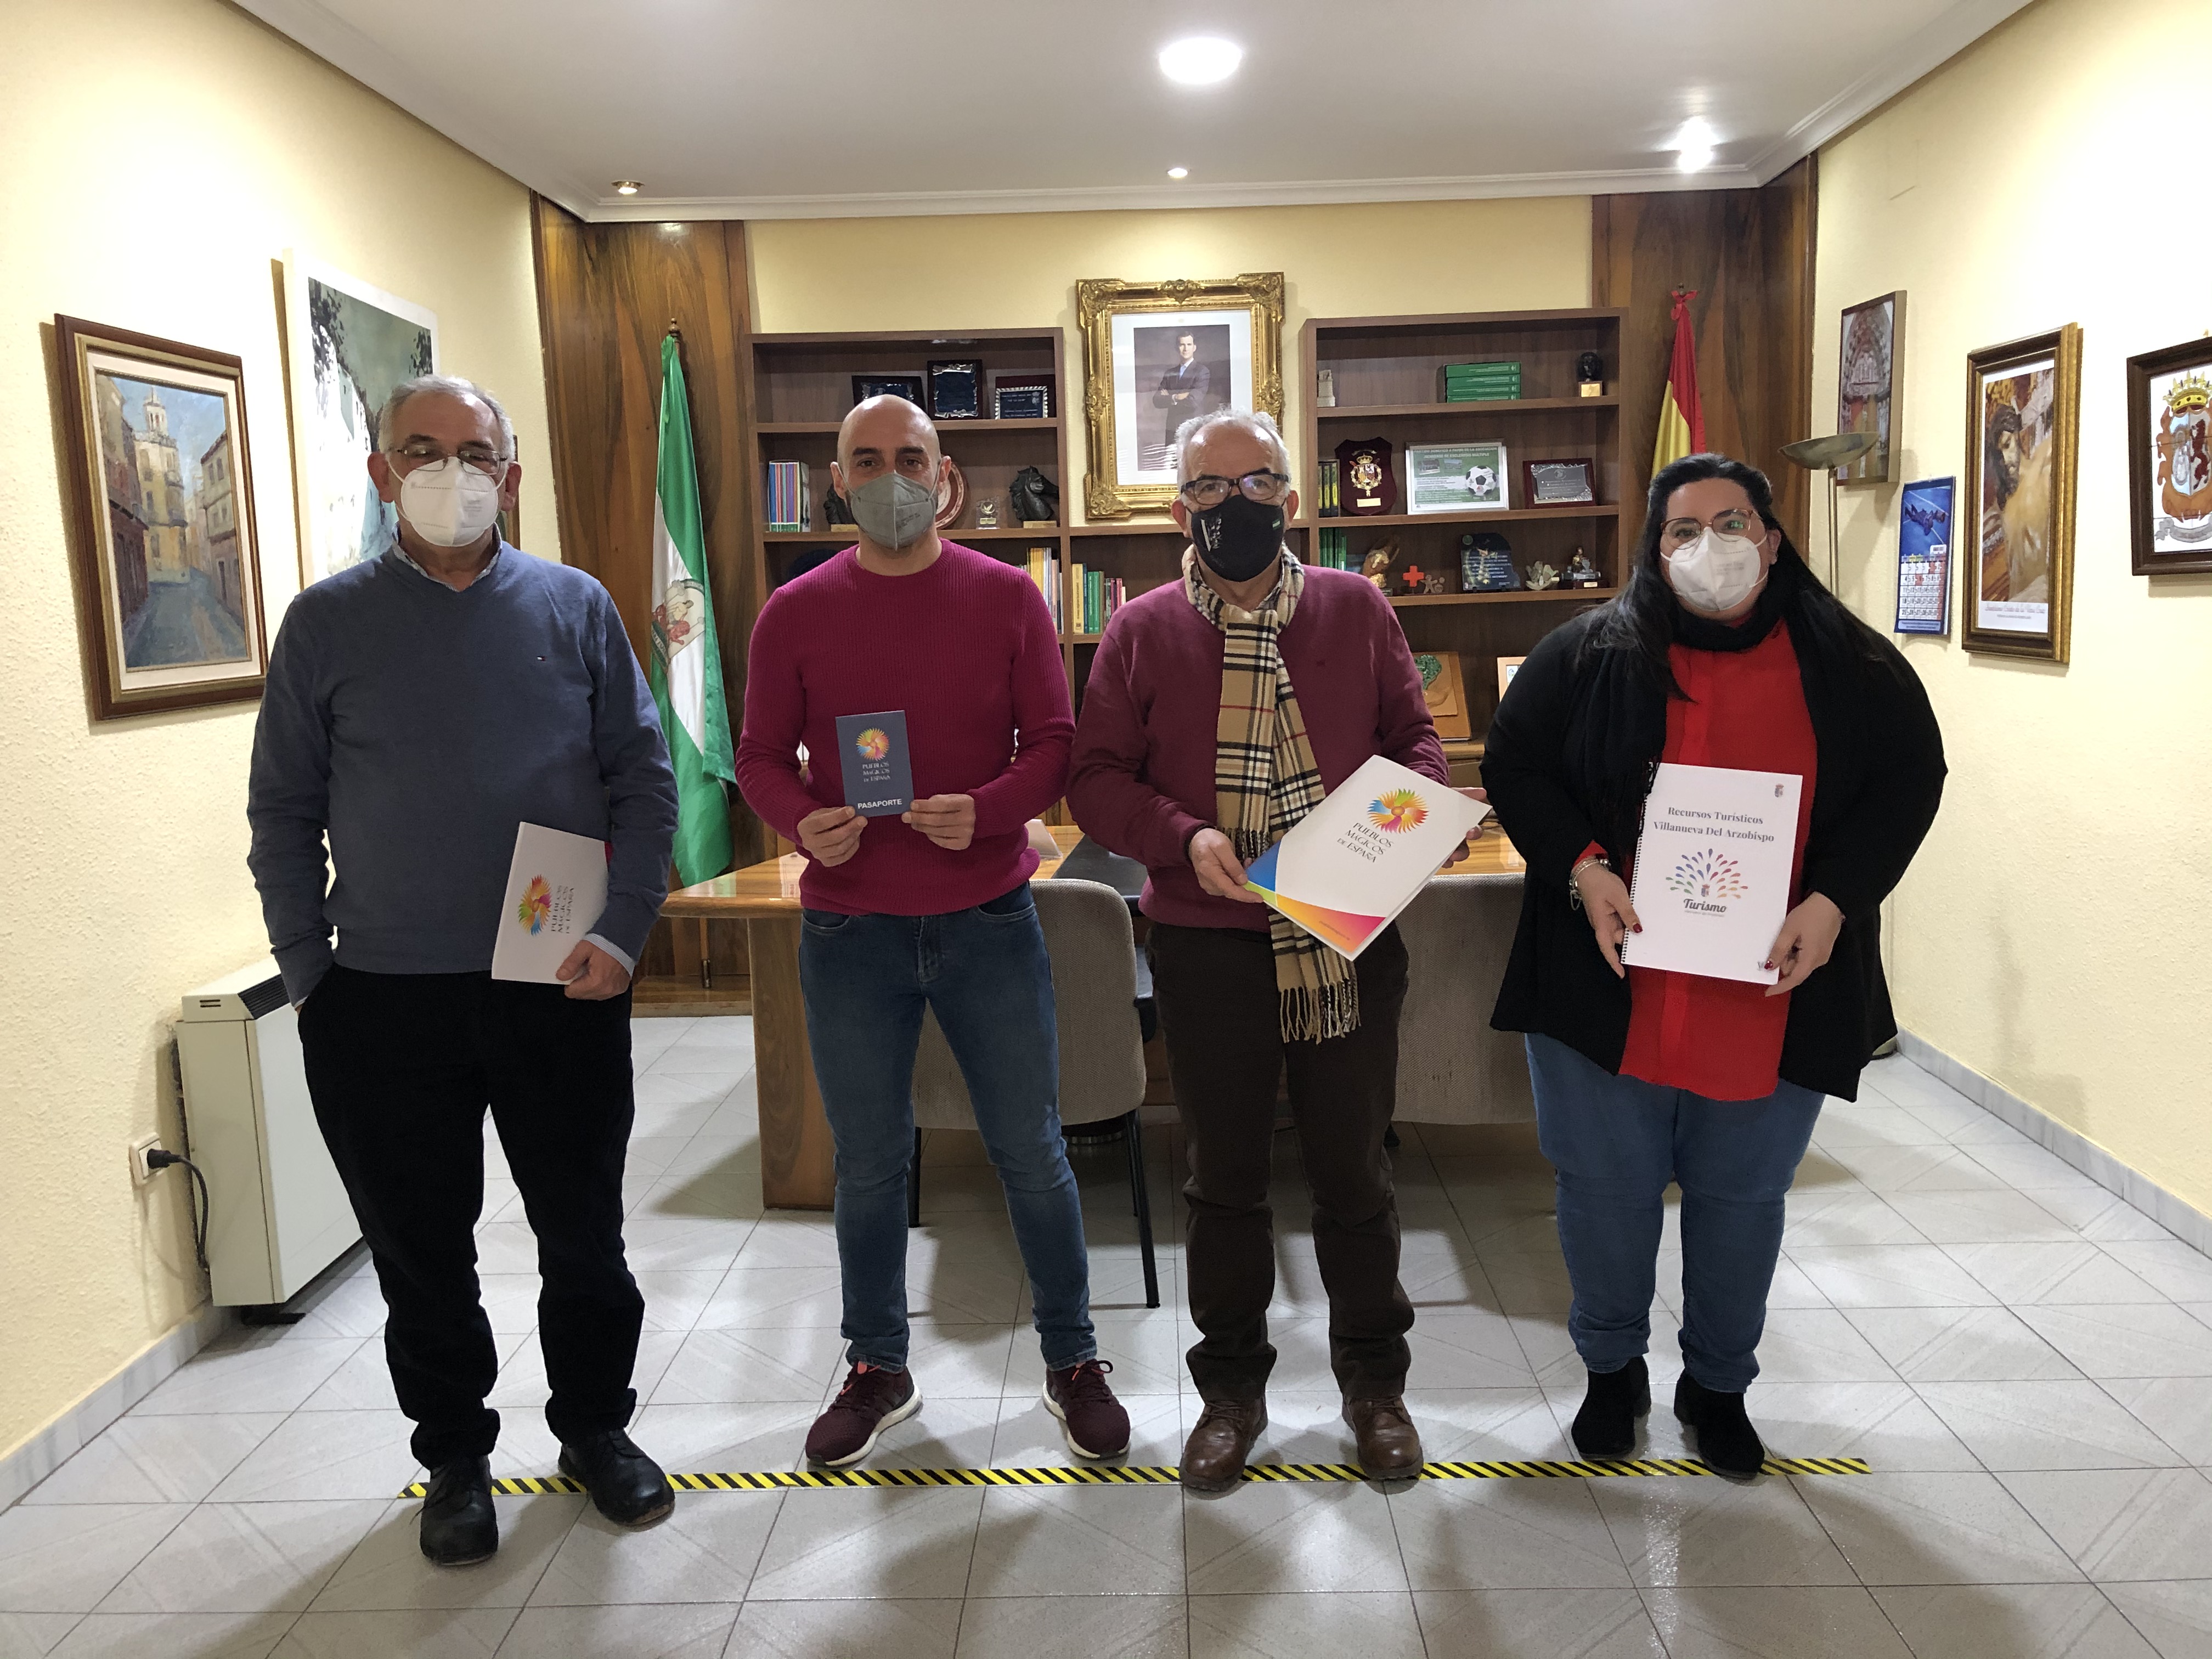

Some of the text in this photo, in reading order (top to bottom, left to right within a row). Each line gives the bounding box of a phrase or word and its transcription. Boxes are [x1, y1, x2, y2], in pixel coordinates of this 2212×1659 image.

[857, 799, 902, 809] PASAPORTE
[1668, 806, 1712, 820] Recursos
[1353, 822, 1394, 848] PUEBLOS
[1654, 821, 1774, 843] Villanueva Del Arzobispo
[1683, 898, 1728, 913] Turismo
